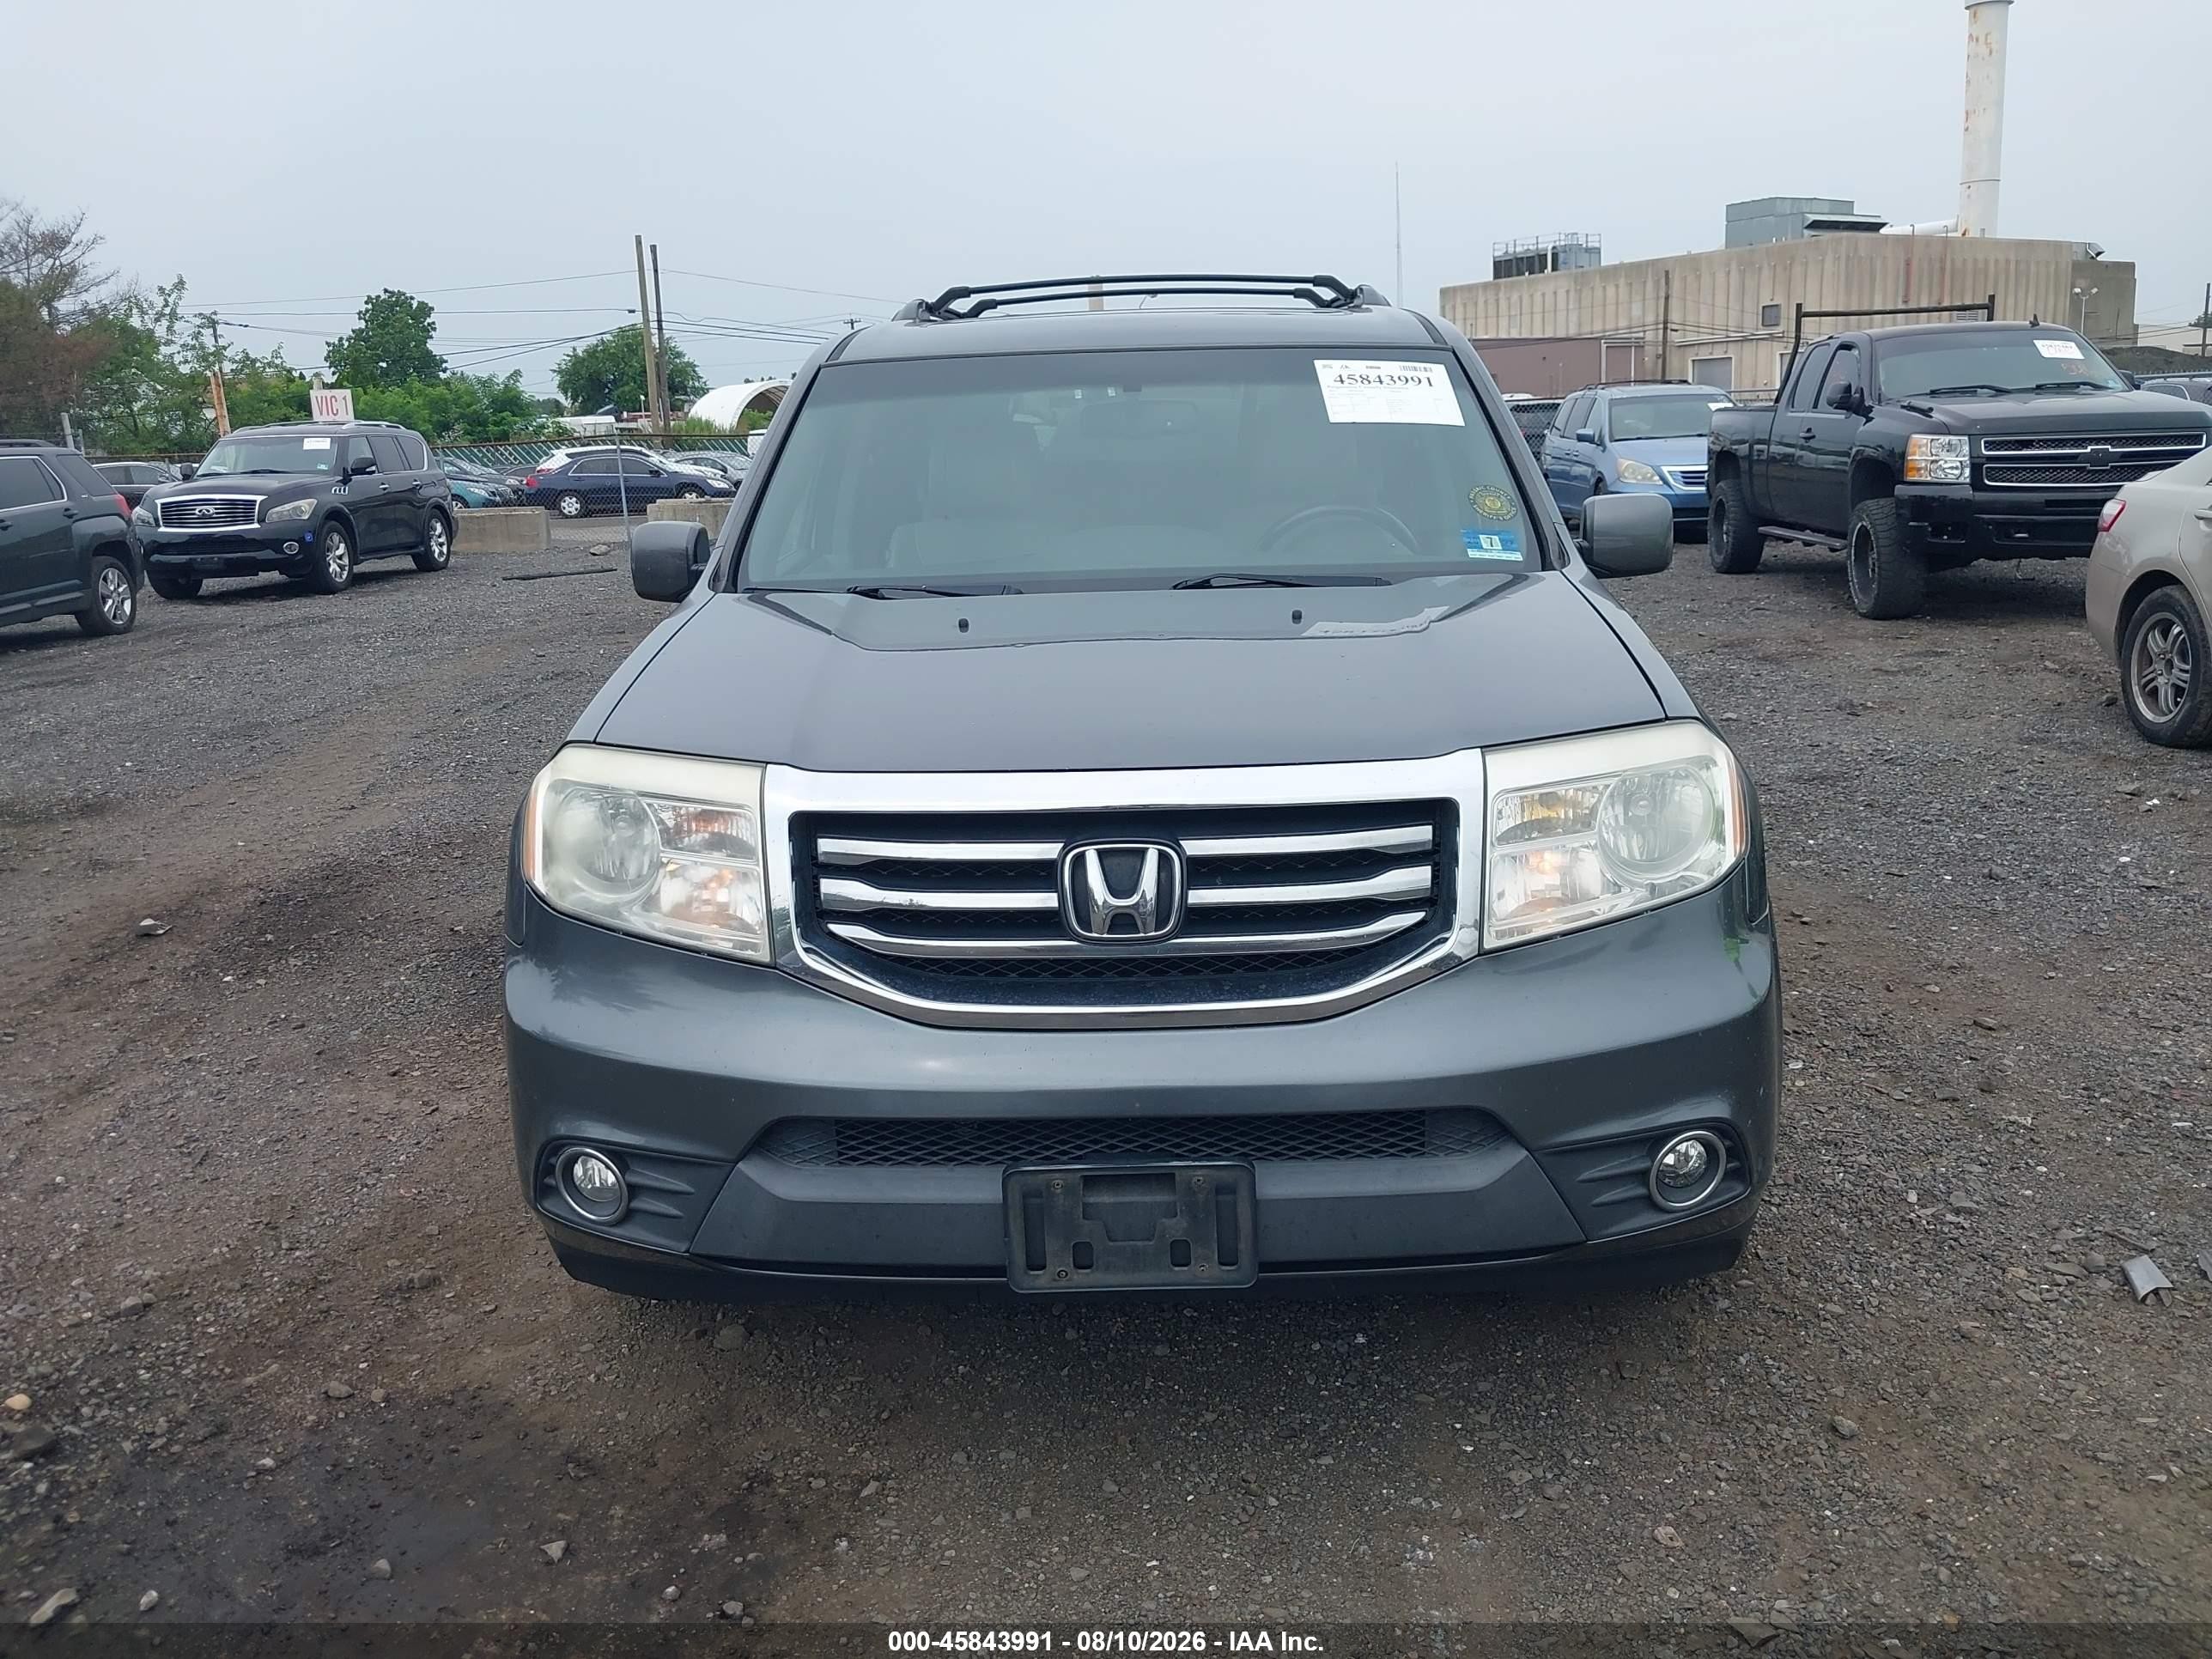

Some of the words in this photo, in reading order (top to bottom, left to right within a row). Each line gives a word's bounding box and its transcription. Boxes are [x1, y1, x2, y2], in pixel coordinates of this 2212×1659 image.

[1334, 374, 1435, 387] 45843991
[315, 395, 338, 416] VIC
[343, 395, 349, 416] 1
[1485, 537, 1494, 548] 7
